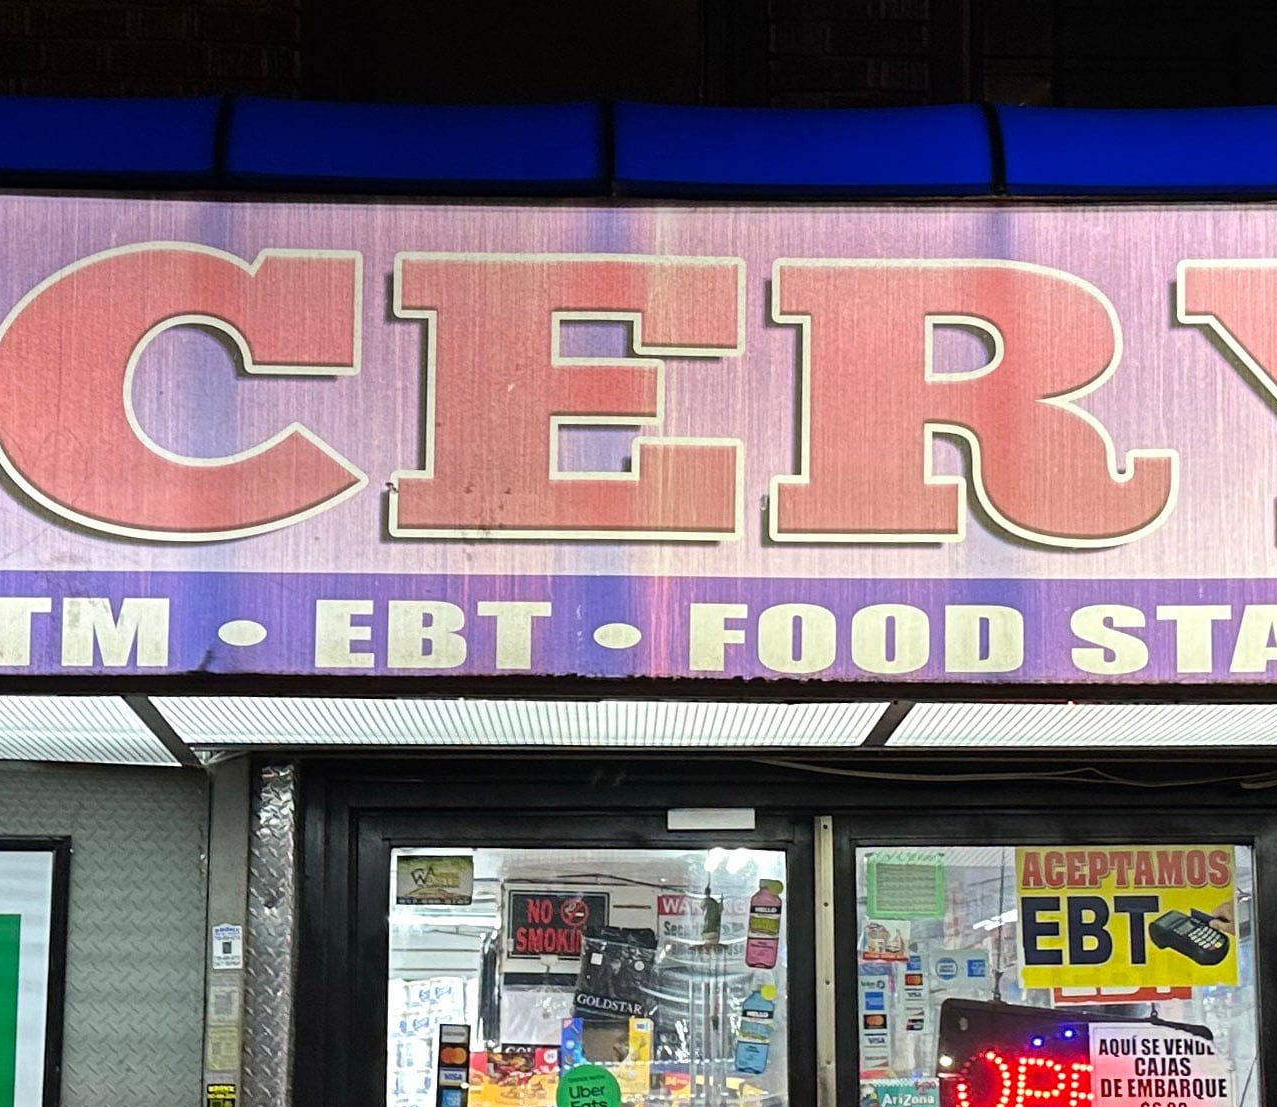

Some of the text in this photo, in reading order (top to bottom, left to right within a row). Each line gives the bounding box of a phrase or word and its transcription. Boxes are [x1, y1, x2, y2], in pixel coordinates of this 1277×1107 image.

[315, 600, 552, 669] EBT
[689, 603, 1025, 674] FOOD
[1021, 849, 1232, 888] ACEPTAMOS
[527, 899, 554, 924] NO
[516, 928, 582, 954] SMOKI
[1021, 894, 1159, 966] EBT
[577, 994, 643, 1015] GOLDSTAR
[1099, 1035, 1136, 1057] AQUÍ
[1141, 1038, 1159, 1055] SE
[1135, 1057, 1191, 1077] CAJAS
[568, 1086, 605, 1099] Uber
[1100, 1078, 1228, 1100] DE EMBARQUE
[882, 1094, 935, 1107] AriZona
